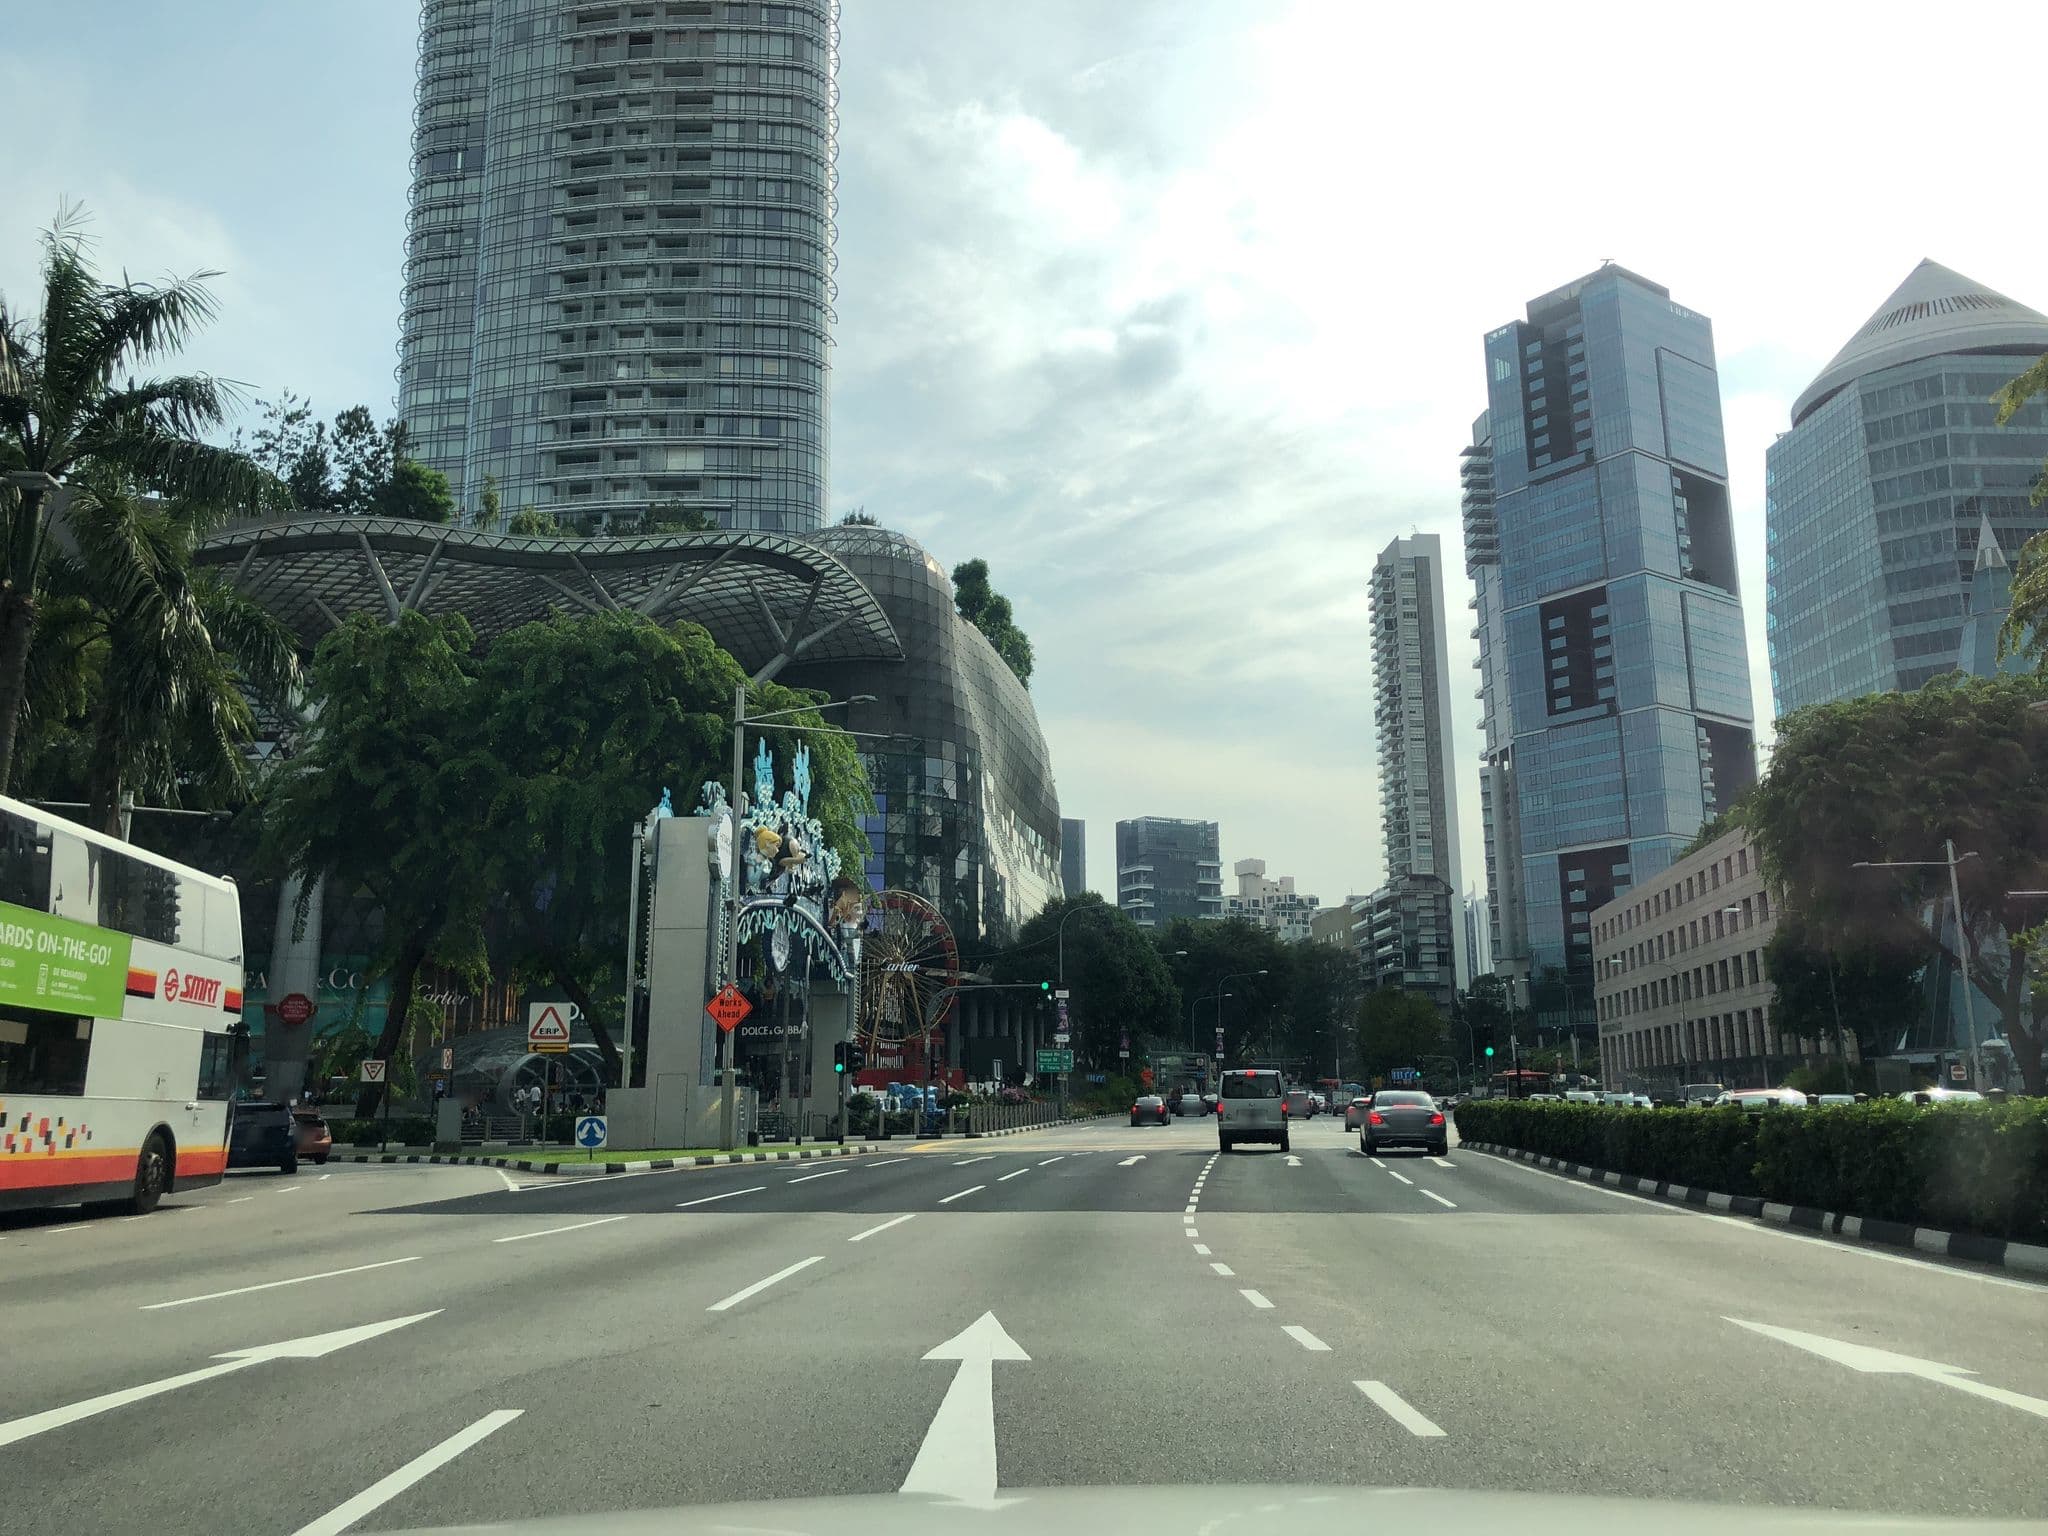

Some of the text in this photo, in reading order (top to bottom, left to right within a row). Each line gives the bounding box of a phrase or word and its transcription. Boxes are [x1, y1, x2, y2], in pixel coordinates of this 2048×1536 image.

[37, 931, 112, 966] ON-THE-GO!
[880, 957, 920, 973] Cartier
[180, 974, 221, 1004] SMRT
[417, 983, 469, 1006] Cartier
[719, 998, 742, 1008] Works
[717, 1010, 741, 1019] Ahead
[539, 1027, 560, 1035] ERP
